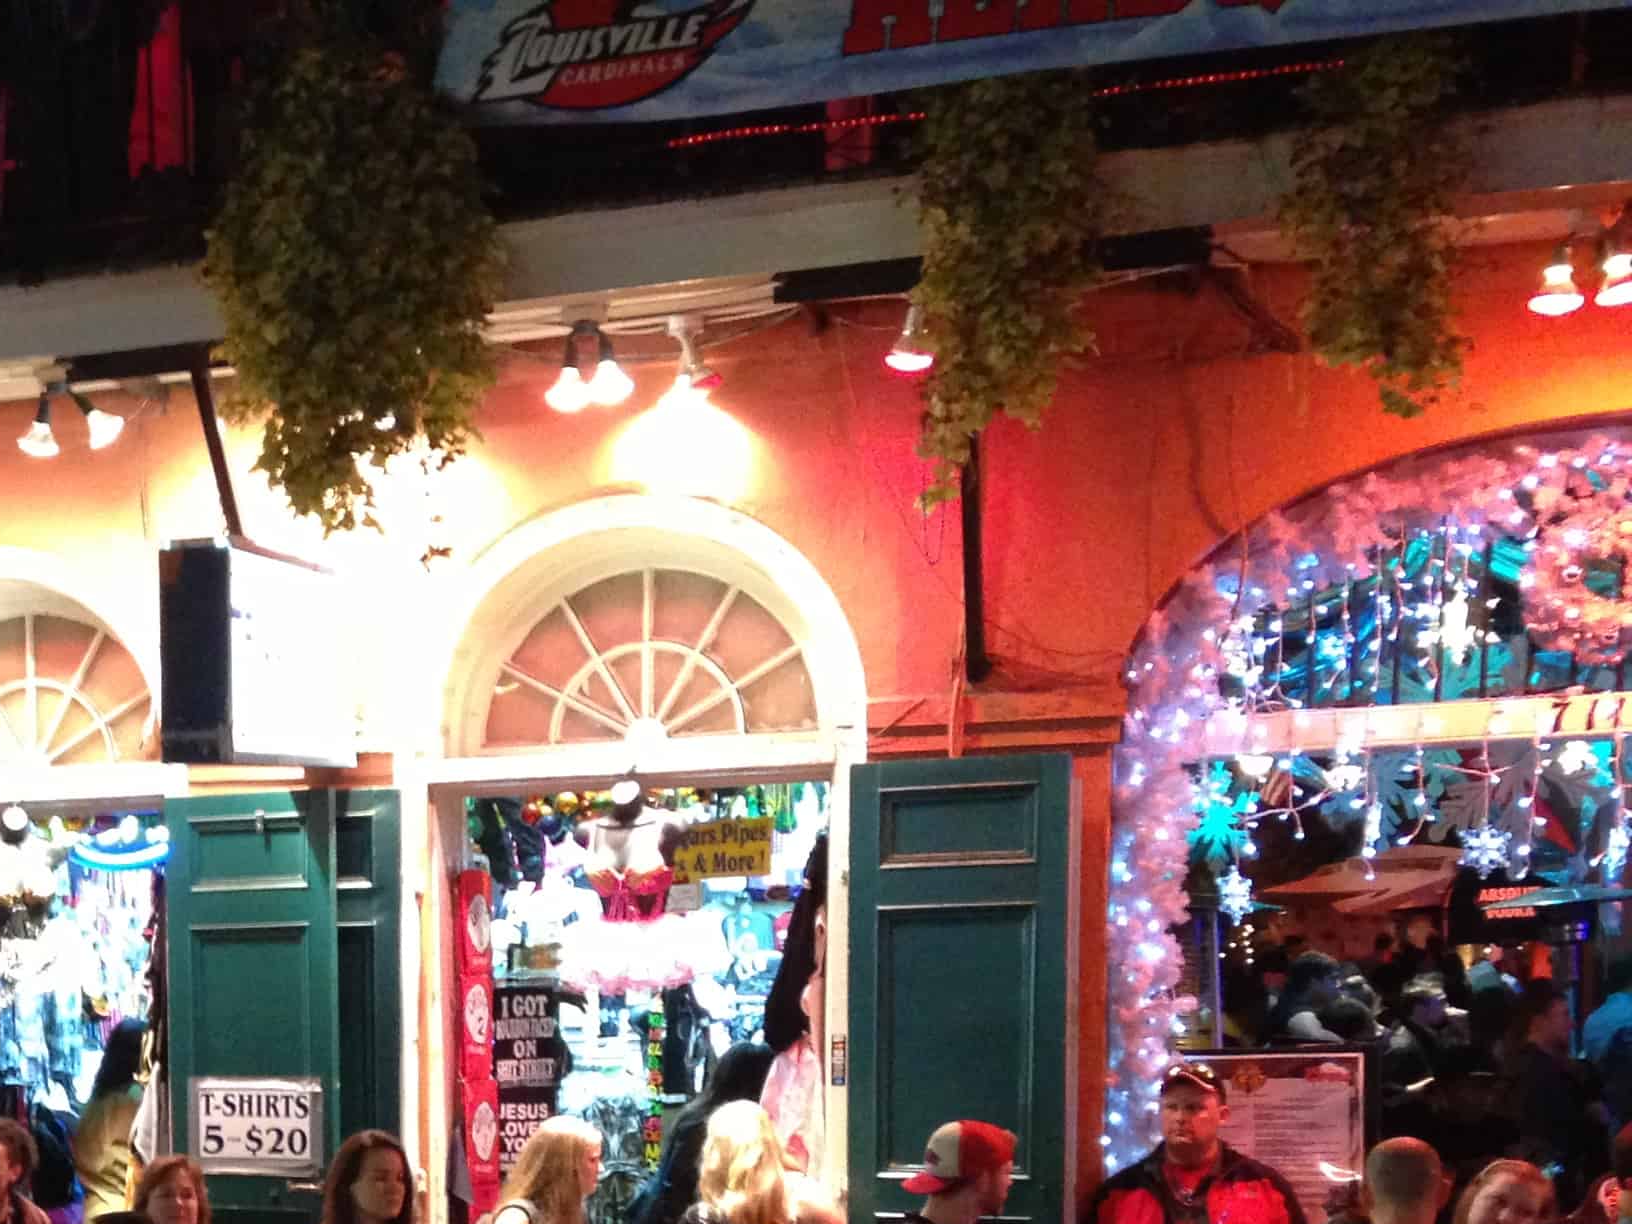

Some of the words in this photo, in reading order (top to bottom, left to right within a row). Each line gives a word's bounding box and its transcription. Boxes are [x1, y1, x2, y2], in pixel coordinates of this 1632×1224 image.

[474, 12, 706, 100] LOUISVILLE
[560, 53, 686, 85] CARDINALS
[721, 822, 767, 848] Pipes
[694, 853, 706, 873] &
[501, 996, 509, 1018] I
[512, 994, 548, 1017] GOT
[513, 1040, 537, 1059] ON
[200, 1093, 309, 1118] T-SHIRTS
[499, 1103, 548, 1120] JESUS
[203, 1124, 224, 1154] 5
[244, 1124, 308, 1157] $20
[500, 1121, 539, 1137] OVE
[503, 1137, 526, 1152] YO
